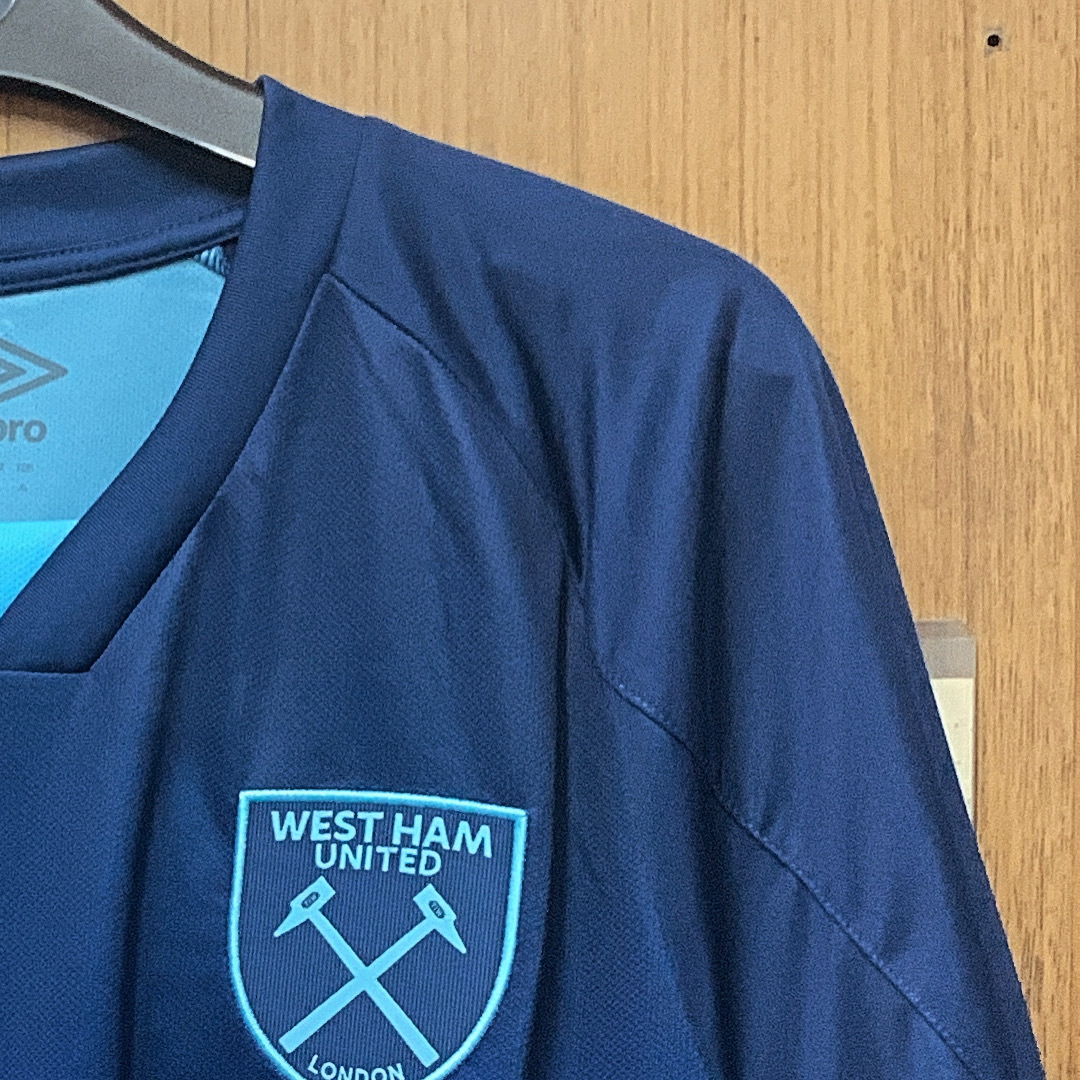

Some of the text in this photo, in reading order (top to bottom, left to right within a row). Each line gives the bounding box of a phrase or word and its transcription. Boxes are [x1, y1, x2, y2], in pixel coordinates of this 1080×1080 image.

[270, 809, 494, 859] WEST HAM
[315, 843, 443, 877] UNITED
